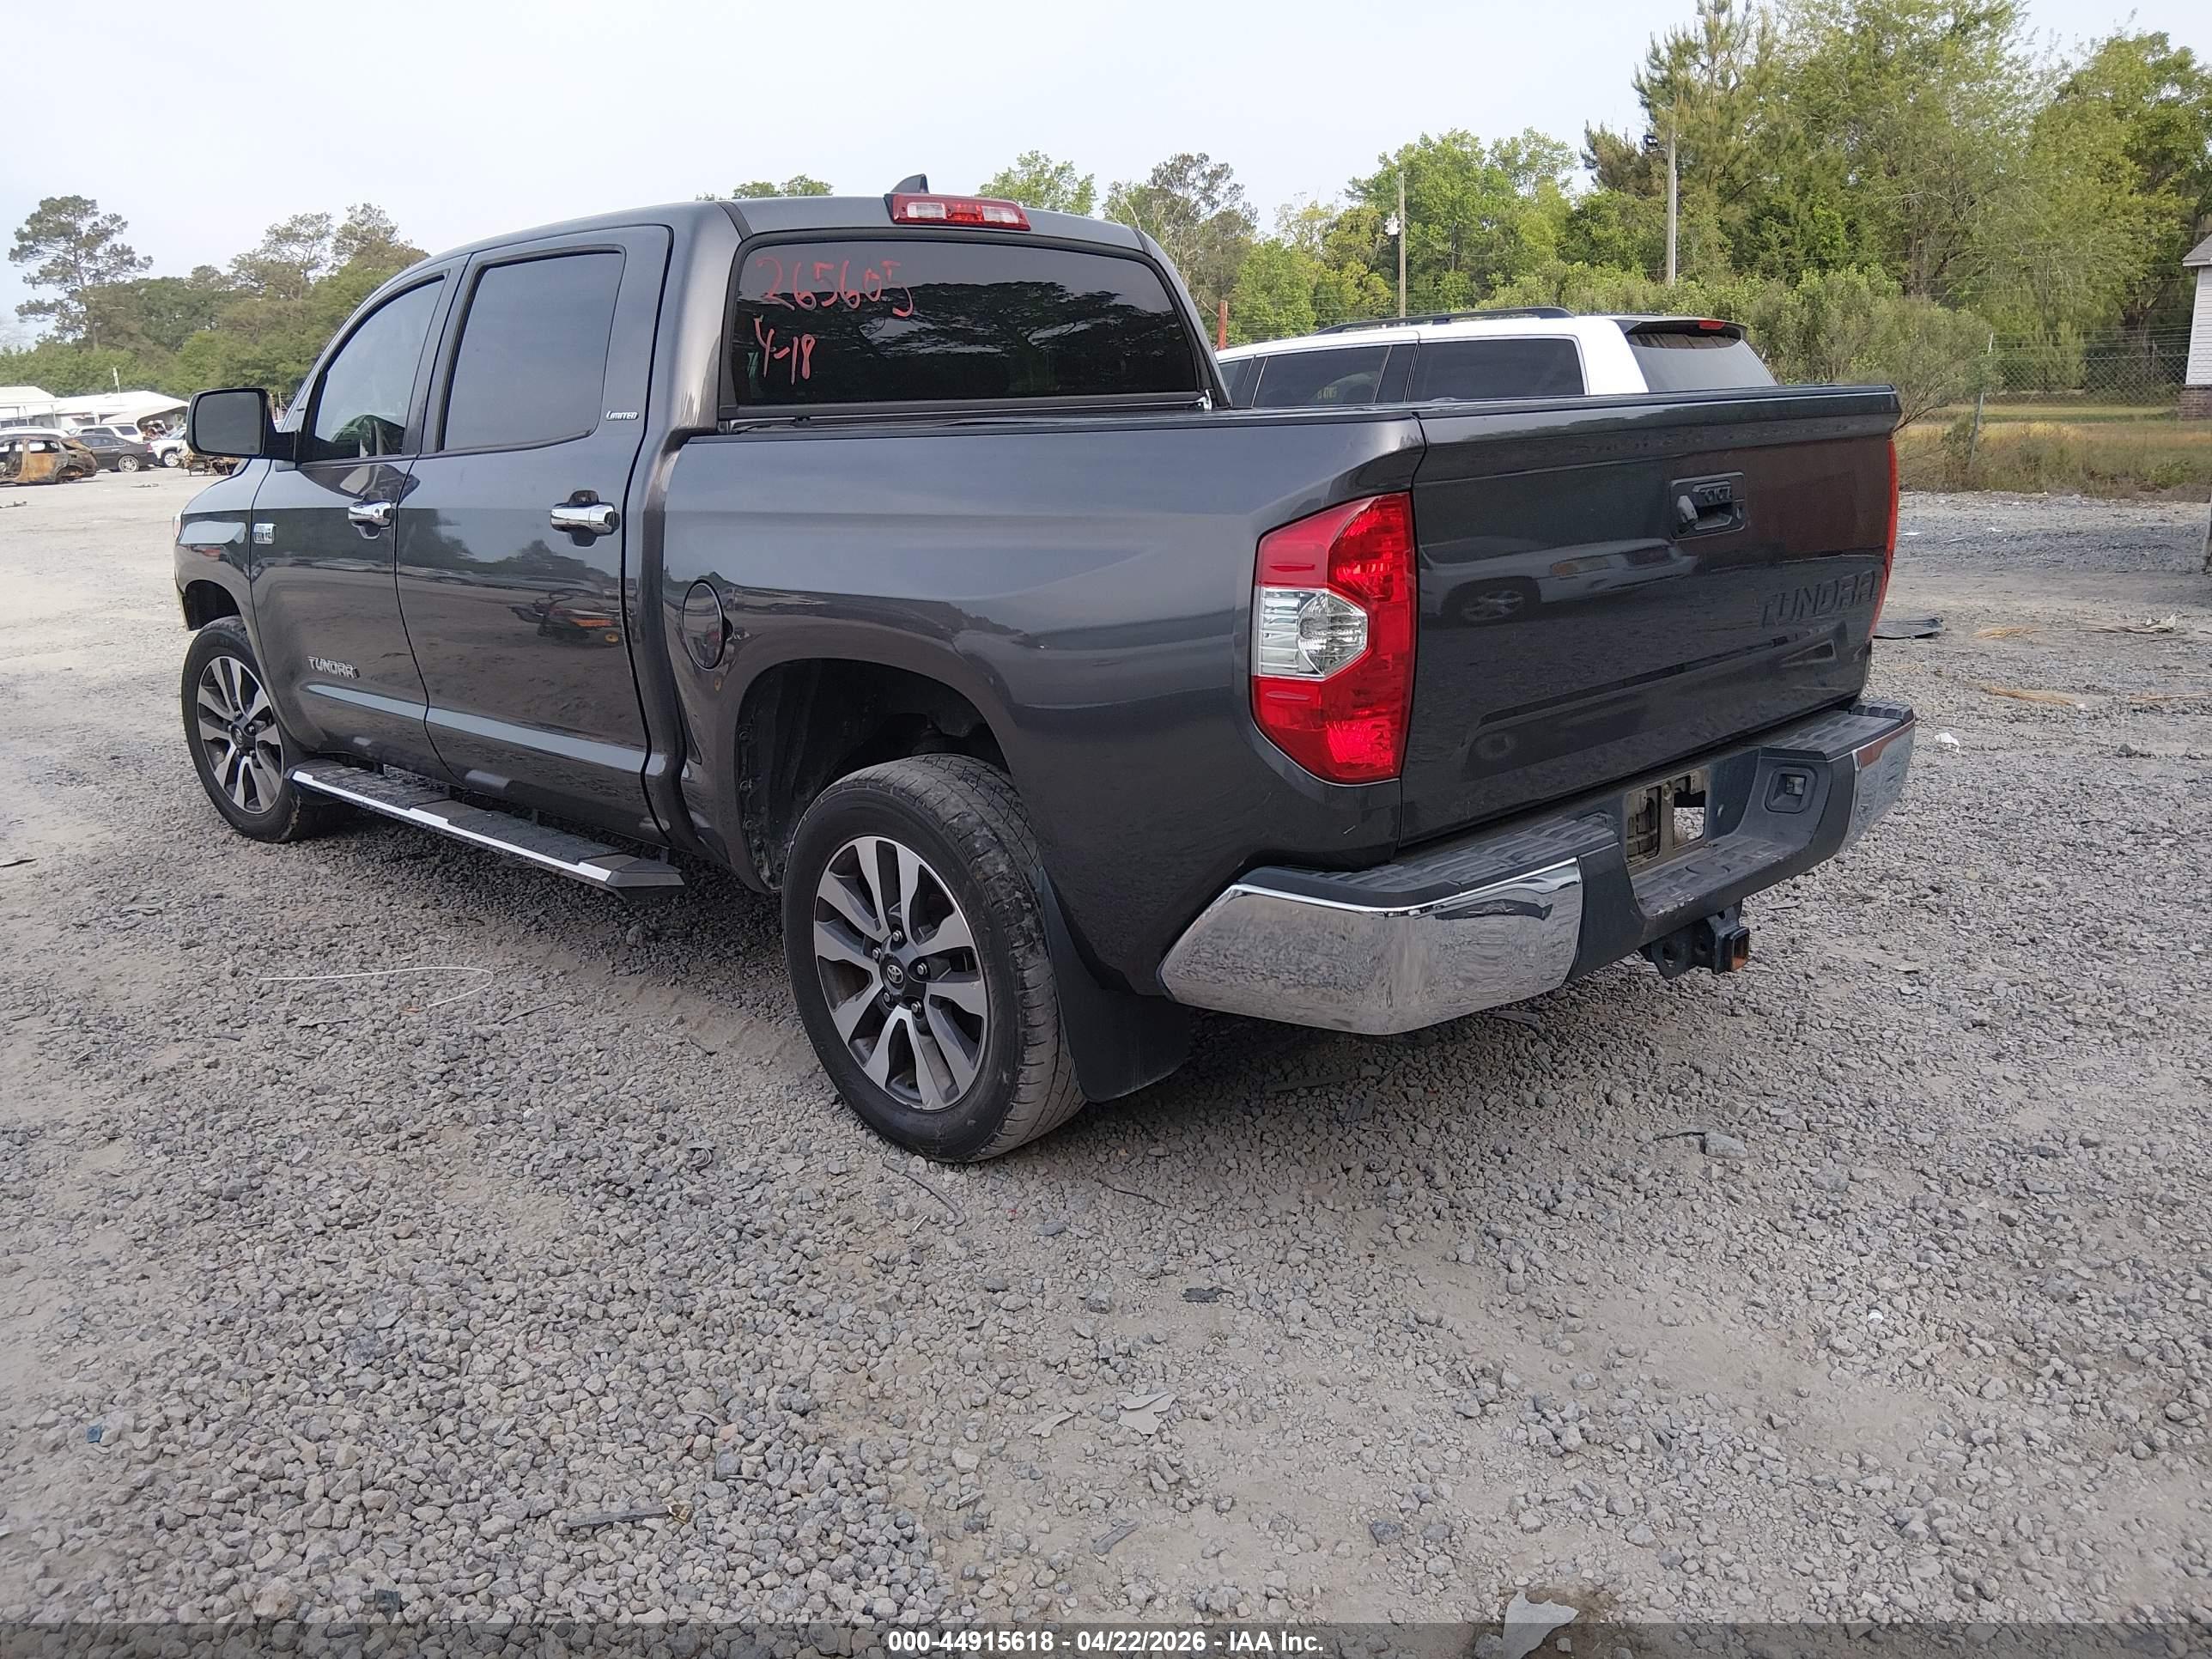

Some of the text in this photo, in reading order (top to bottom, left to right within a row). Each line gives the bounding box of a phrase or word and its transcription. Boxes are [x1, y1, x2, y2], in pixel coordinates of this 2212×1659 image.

[756, 257, 914, 317] 265605
[1761, 570, 1875, 629] TUNDRA
[307, 655, 359, 679] TUNDRA
